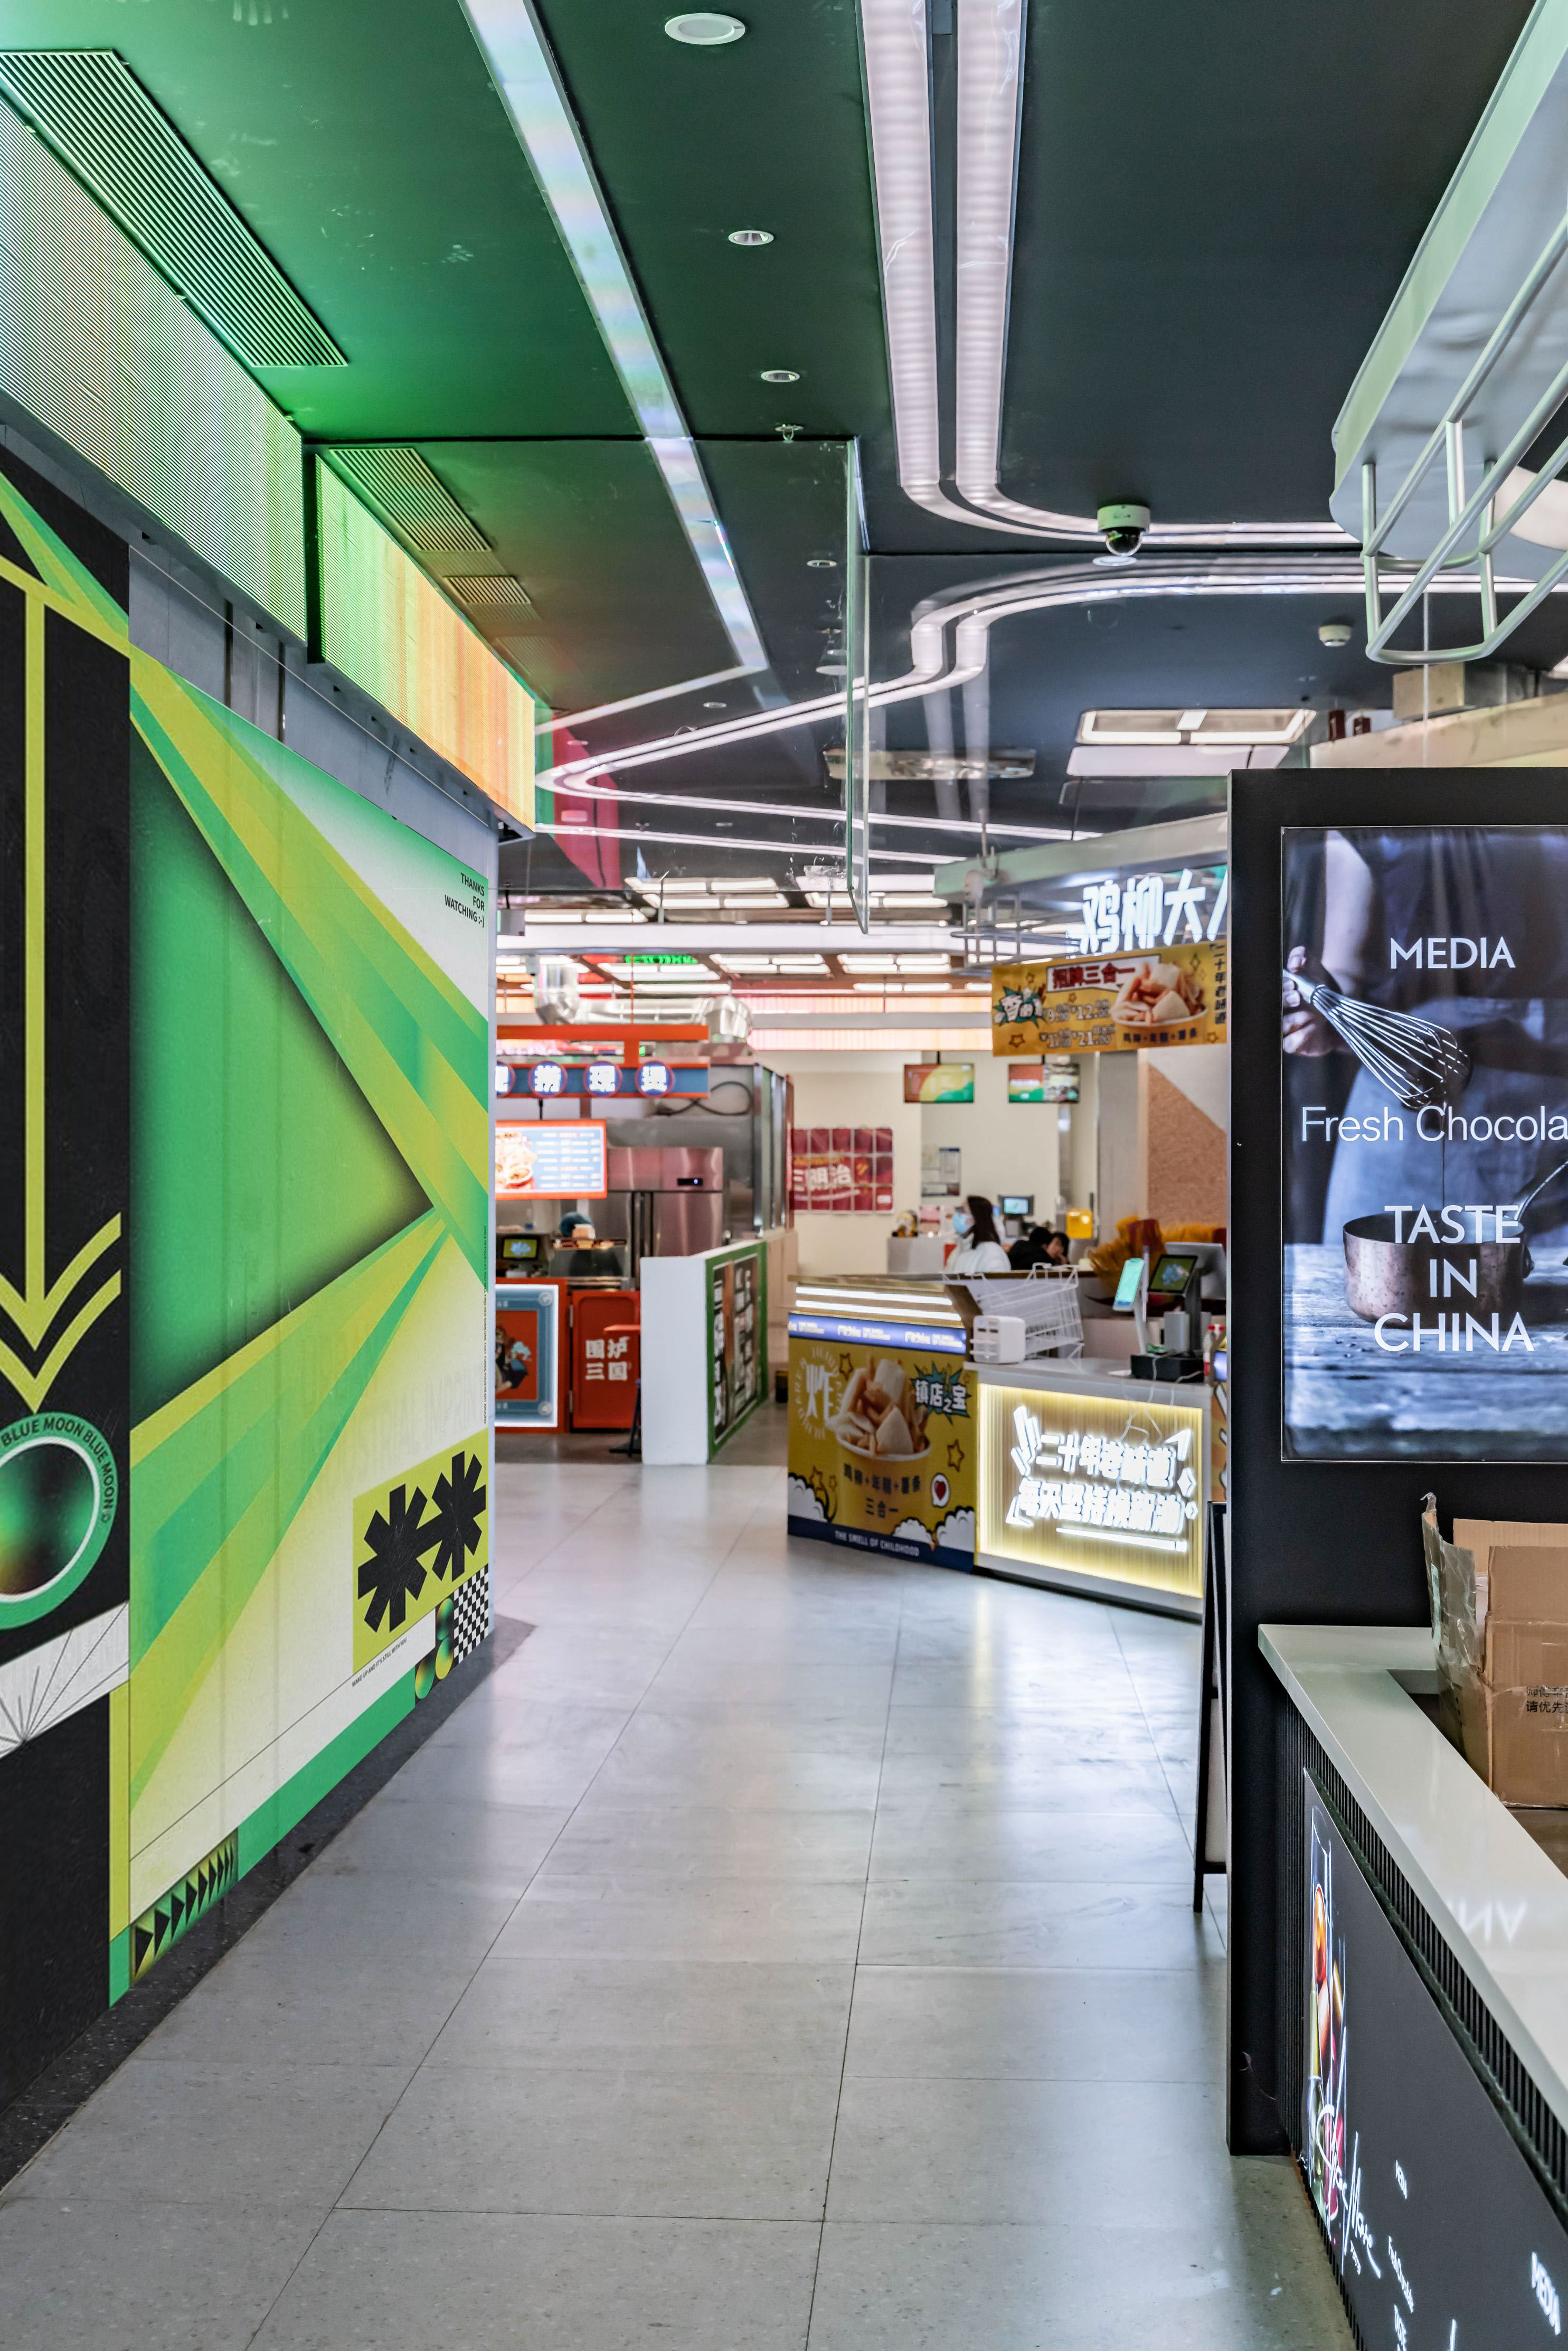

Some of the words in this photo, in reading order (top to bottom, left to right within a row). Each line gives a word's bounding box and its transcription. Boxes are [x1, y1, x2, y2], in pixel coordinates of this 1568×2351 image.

[460, 872, 485, 896] THANKS
[445, 895, 477, 922] WATCHING
[473, 896, 485, 911] FOR
[1391, 936, 1516, 969] MEDIA
[1302, 1106, 1403, 1141] Fresh
[1416, 1105, 1568, 1141] Chocola
[1384, 1204, 1520, 1244] TASTE
[1430, 1258, 1477, 1297] IN
[1374, 1312, 1535, 1352] CHINA
[916, 1380, 967, 1413] 镇店之宝
[1, 1419, 40, 1447] BLUE
[43, 1417, 84, 1437] MOON
[82, 1430, 108, 1463] BLUE
[100, 1462, 115, 1509] MOON
[1035, 1434, 1176, 1488] 二十年老味道
[866, 1497, 898, 1518] 三合一
[835, 1530, 847, 1541] THE
[848, 1534, 868, 1546] SMELL
[870, 1538, 879, 1547] OF
[880, 1540, 920, 1557] CHILDHOOD
[1531, 2251, 1562, 2336] MEDIA
